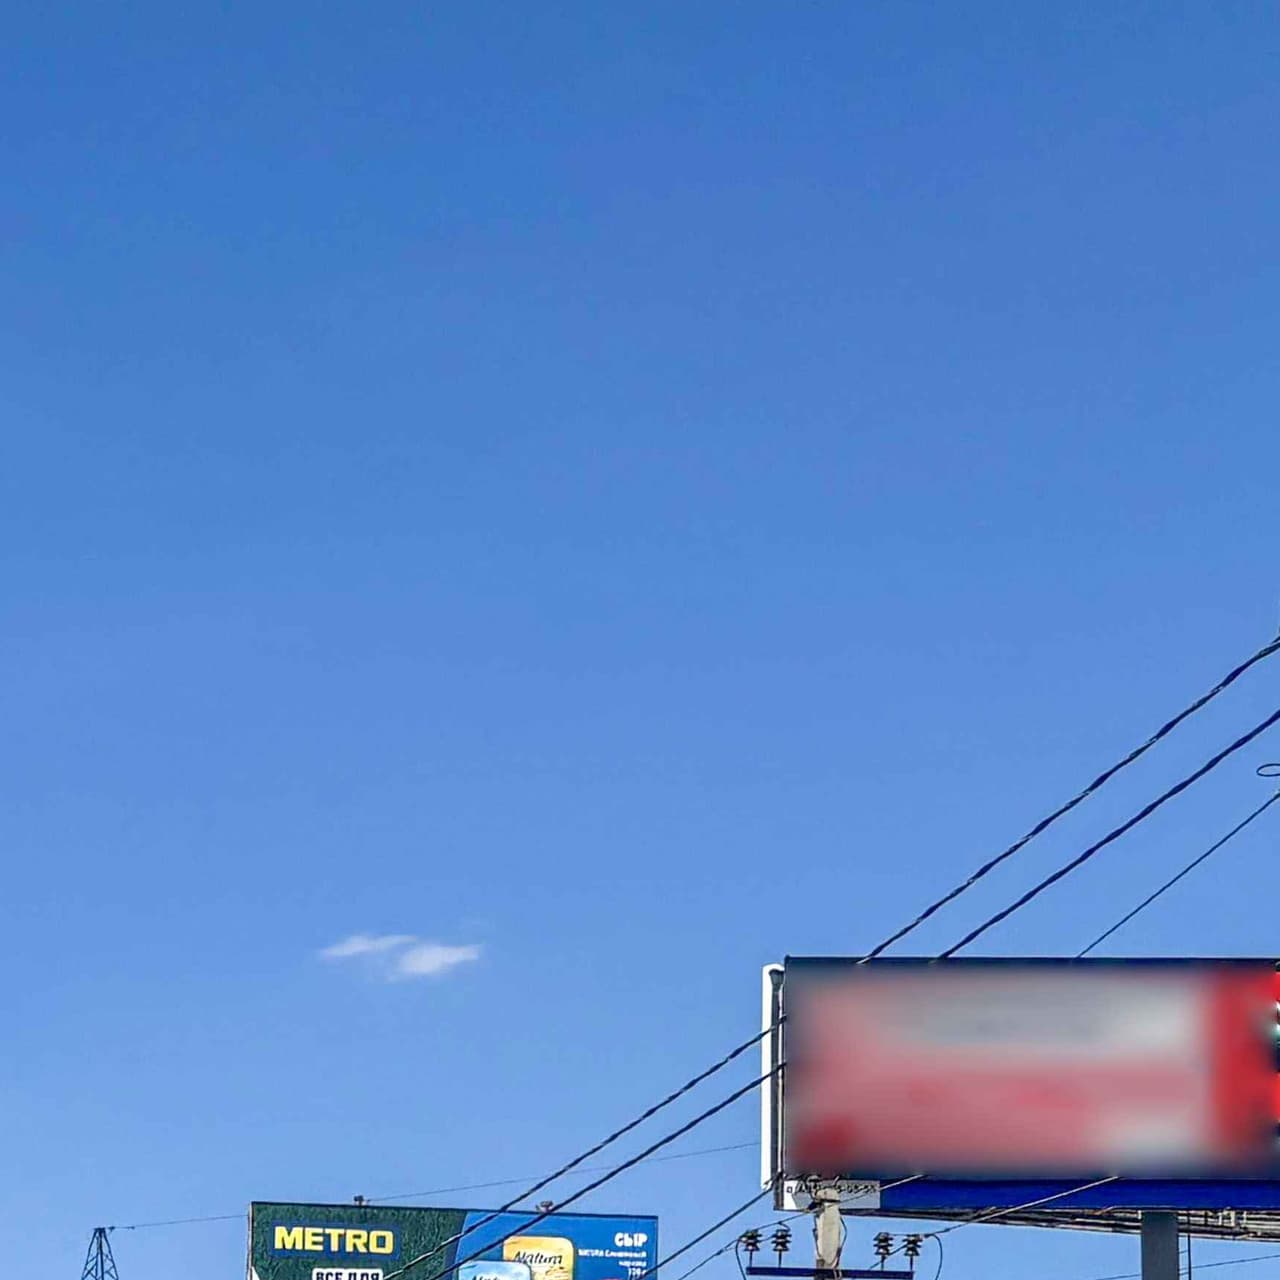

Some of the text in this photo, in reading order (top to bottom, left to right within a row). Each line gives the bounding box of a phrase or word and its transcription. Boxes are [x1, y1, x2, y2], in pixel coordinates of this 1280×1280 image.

[274, 1226, 394, 1254] METRO
[614, 1232, 648, 1247] СЫР
[513, 1250, 563, 1265] Natura
